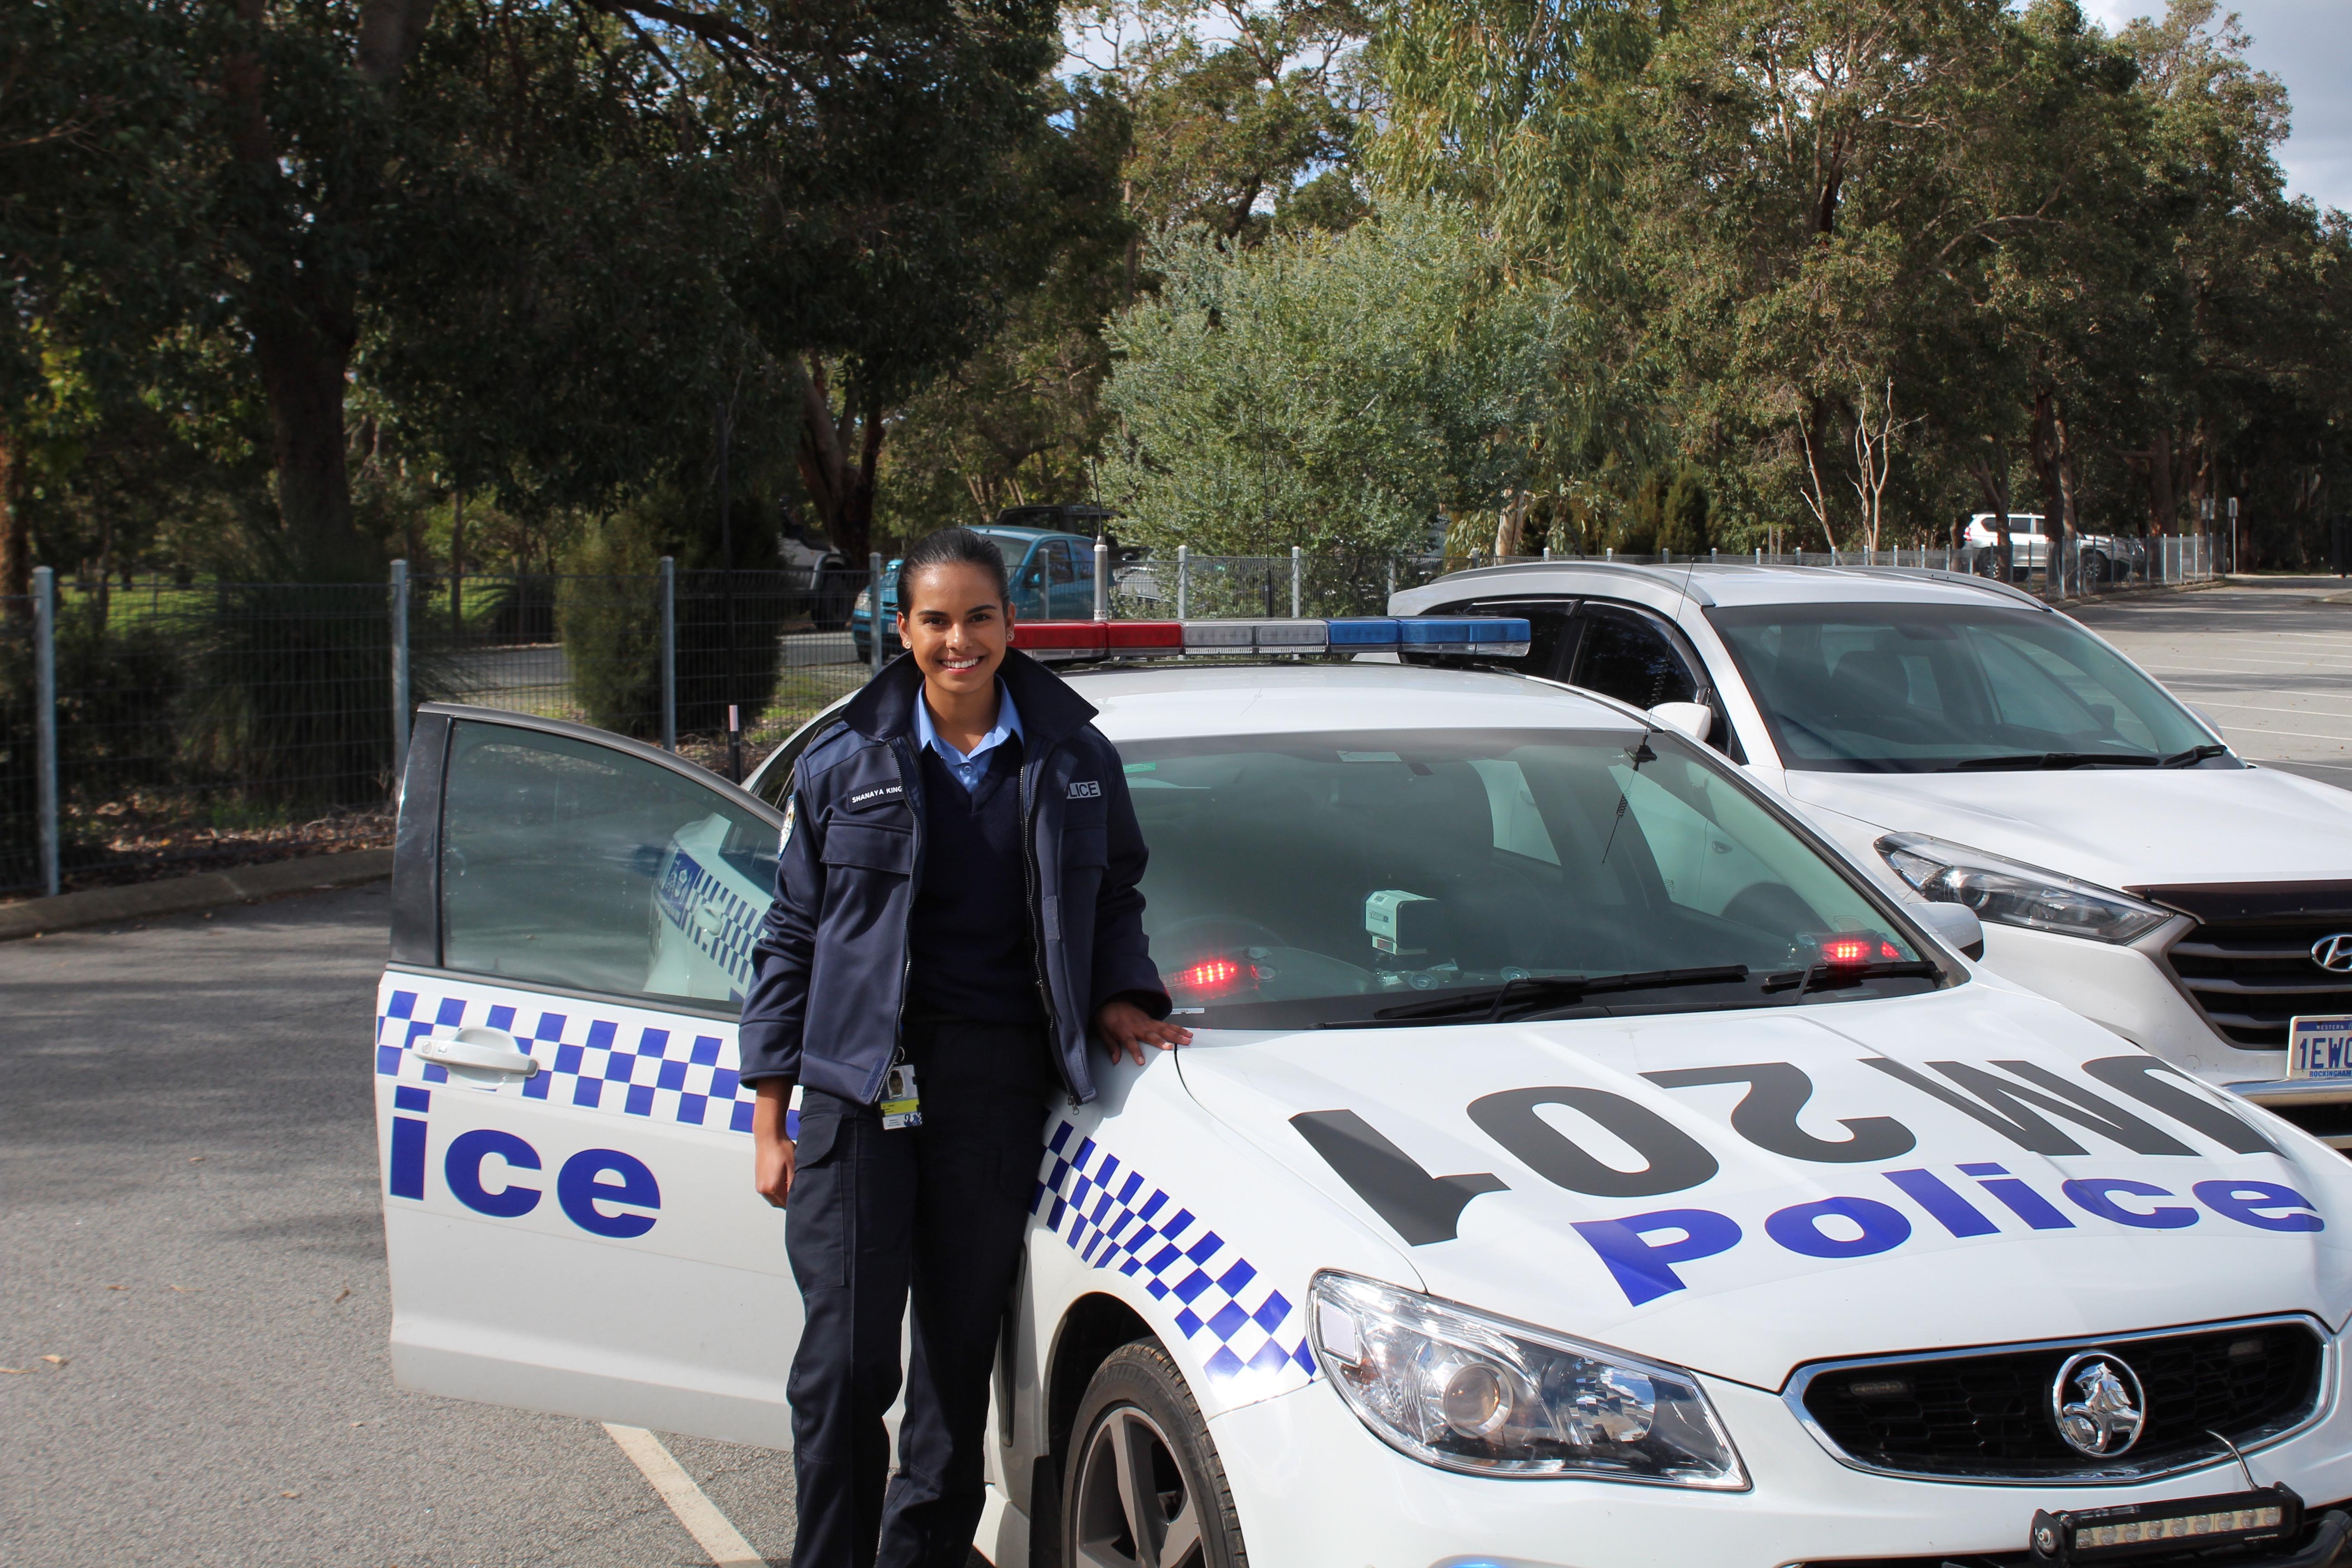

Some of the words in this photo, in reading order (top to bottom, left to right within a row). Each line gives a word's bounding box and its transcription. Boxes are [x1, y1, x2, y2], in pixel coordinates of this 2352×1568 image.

[852, 789, 884, 803] SHANAYA
[886, 786, 903, 794] KING
[2309, 1069, 2352, 1078] ROCKINGHAM
[1568, 1162, 2325, 1307] Police
